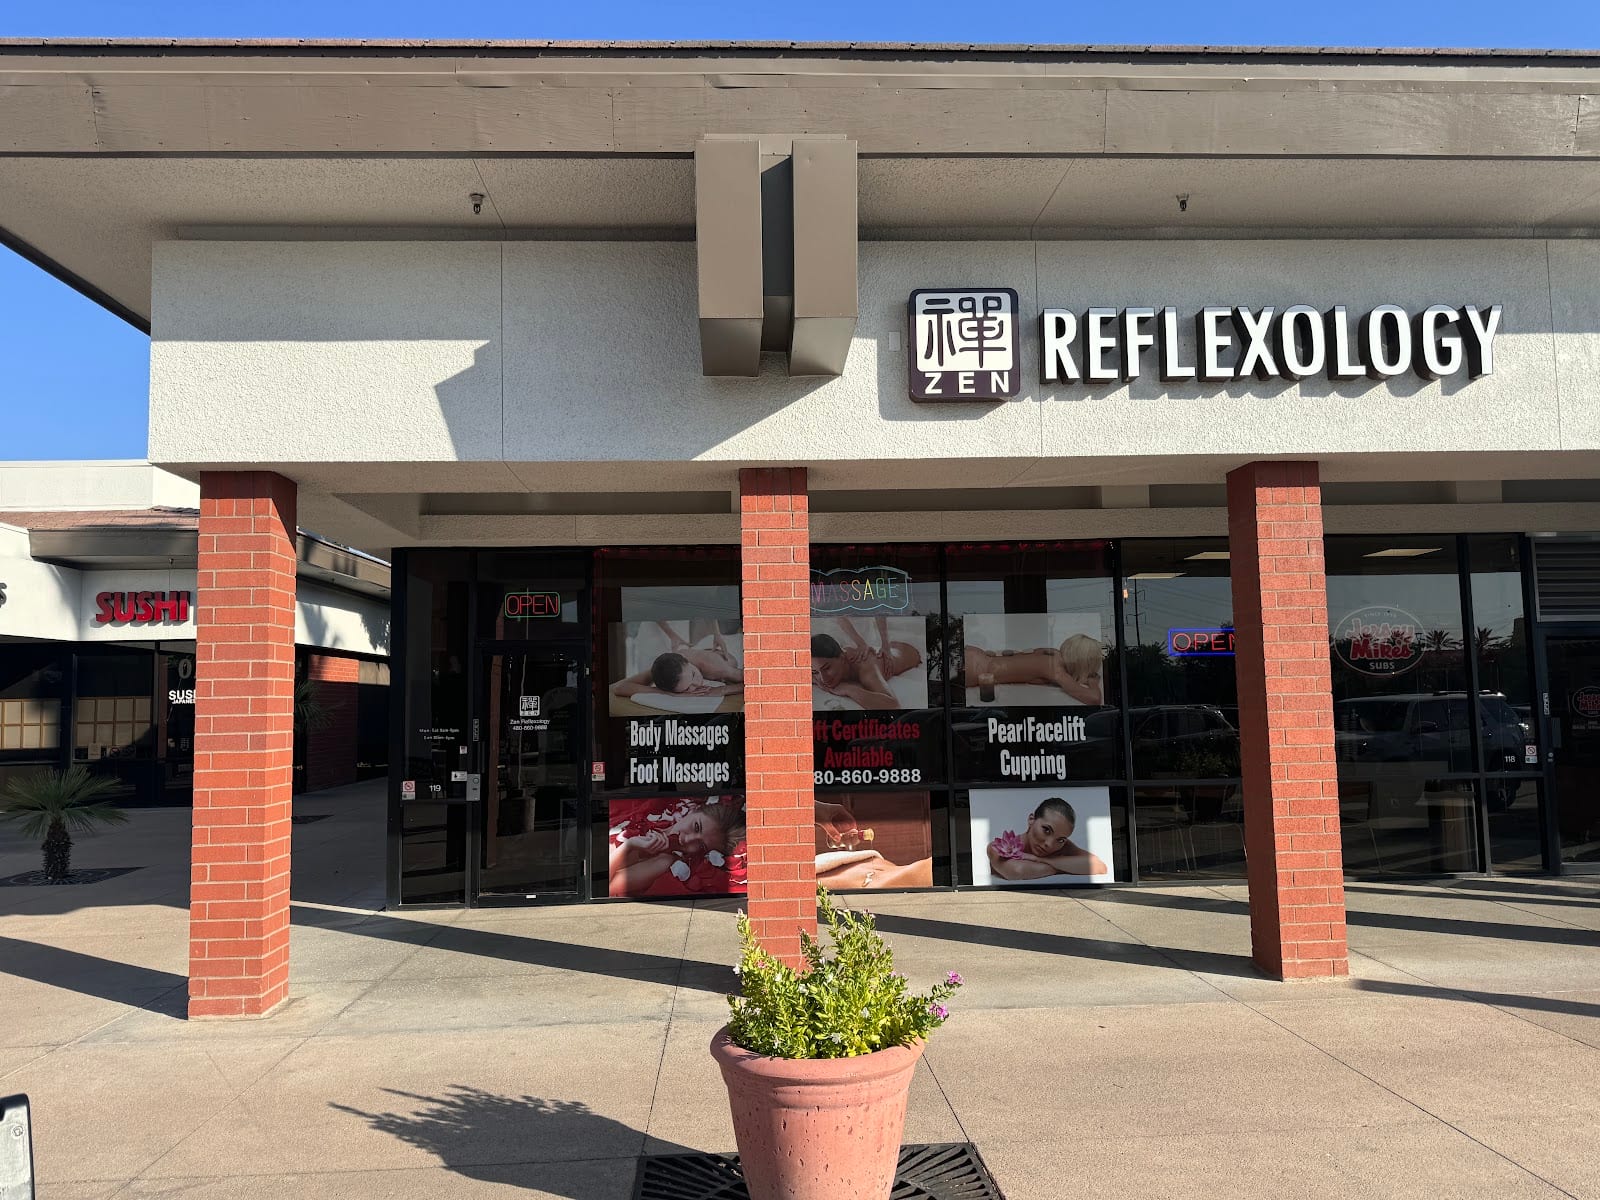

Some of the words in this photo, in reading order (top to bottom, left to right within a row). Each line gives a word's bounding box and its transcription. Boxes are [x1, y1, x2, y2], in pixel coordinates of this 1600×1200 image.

[1042, 303, 1503, 385] REFLEXOLOGY
[924, 371, 1010, 394] ZEN
[810, 577, 900, 603] MASSAGE
[96, 591, 190, 622] SUSHI
[506, 594, 560, 615] OPEN
[1369, 661, 1395, 670] SUBS
[630, 719, 662, 752] Body
[665, 719, 730, 751] Massages
[831, 718, 921, 741] Certificates
[1027, 715, 1087, 742] Facelift
[823, 745, 894, 769] Available
[1000, 749, 1067, 781] Cupping
[1504, 755, 1516, 763] 118
[630, 757, 659, 784] Foot
[662, 756, 730, 788] Massages
[814, 768, 922, 785] 80-860-9888
[429, 784, 442, 792] 119
